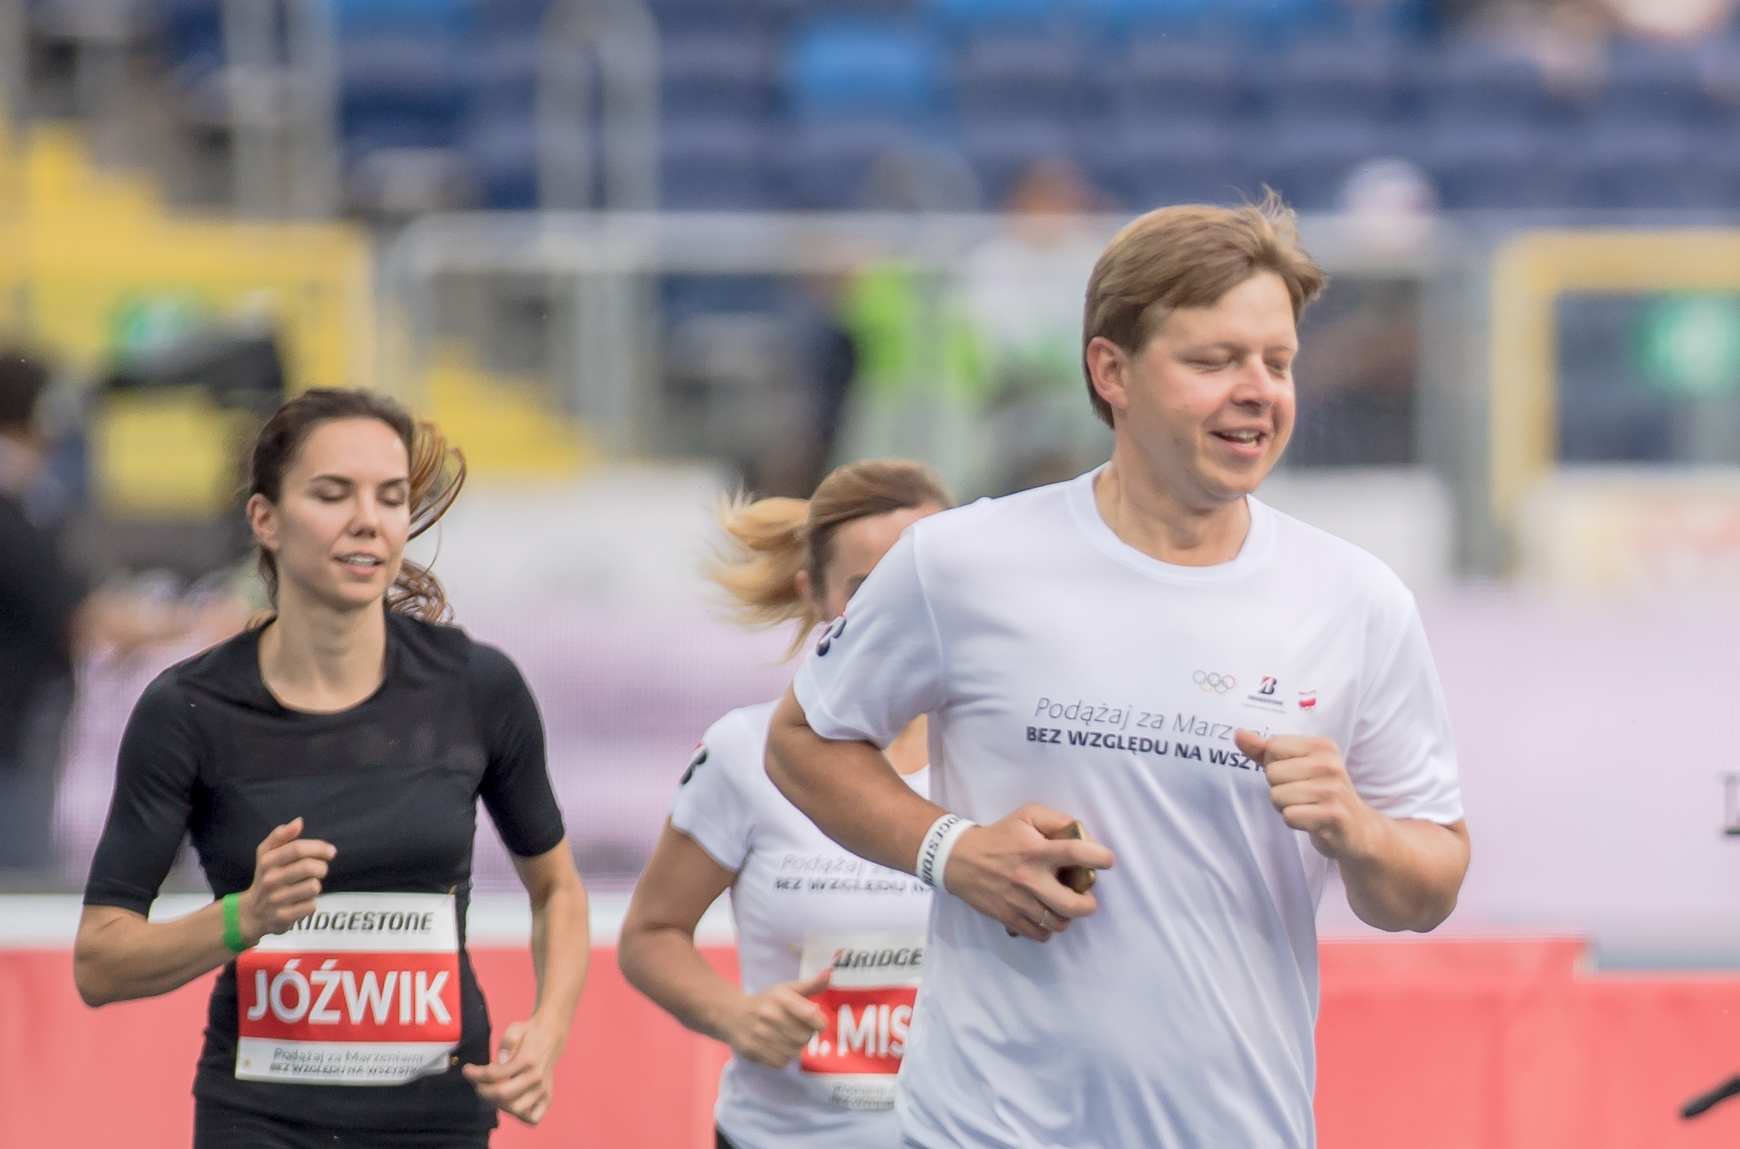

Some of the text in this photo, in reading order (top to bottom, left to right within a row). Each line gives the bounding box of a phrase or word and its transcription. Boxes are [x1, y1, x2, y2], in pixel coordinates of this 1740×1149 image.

[1034, 698, 1132, 730] Podążaj
[1136, 711, 1164, 729] za
[1026, 726, 1061, 744] BEZ
[1067, 730, 1168, 755] WZGLĘDU
[1174, 743, 1202, 761] NA
[247, 959, 452, 1025] JÓŹWIK
